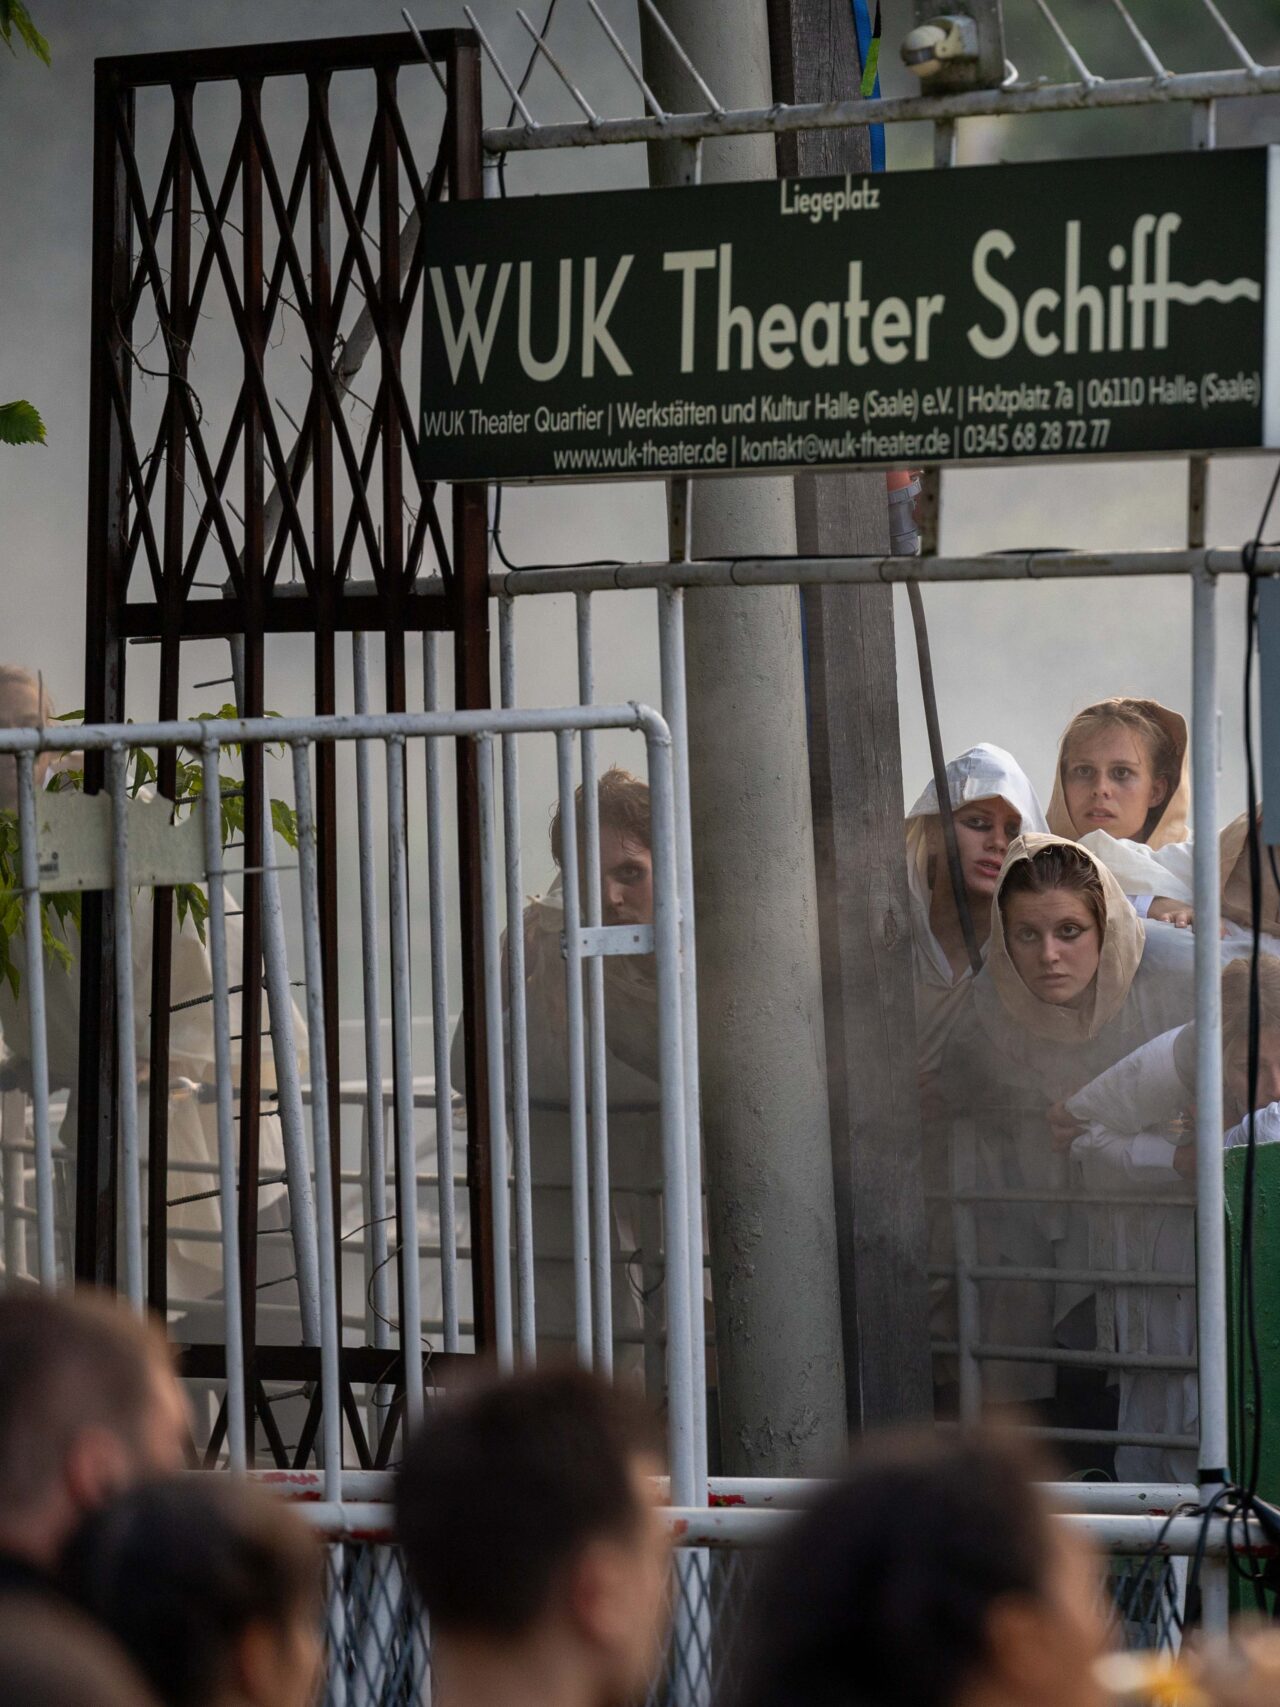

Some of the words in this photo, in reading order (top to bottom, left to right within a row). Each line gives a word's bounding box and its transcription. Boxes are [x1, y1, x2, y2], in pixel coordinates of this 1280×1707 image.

[780, 175, 880, 223] Liegeplatz
[429, 254, 635, 385] WUK
[663, 243, 945, 373] Theater
[967, 212, 1260, 359] Schiff
[423, 410, 465, 437] WUK
[469, 409, 531, 435] Theater
[534, 403, 604, 433] Quartier
[617, 400, 717, 429] Werkstätten
[721, 396, 756, 424] und
[760, 394, 811, 422] Kultur
[814, 392, 860, 419] Halle
[863, 389, 919, 423] (Saale)
[922, 387, 954, 415] e.V.
[968, 383, 1051, 417] Holzplatz
[1054, 380, 1074, 409] 7a
[1087, 377, 1145, 408] 06110
[1148, 375, 1198, 404] Halle
[1200, 371, 1260, 409] (Saale)
[552, 435, 729, 470] www.wuk-theater.de
[740, 426, 951, 463] kontakt@wuk-theater.de
[963, 423, 1009, 453] 0345
[1011, 421, 1037, 452] 68
[1040, 420, 1062, 450] 28
[1066, 419, 1088, 449] 72
[1089, 417, 1111, 447] 77
